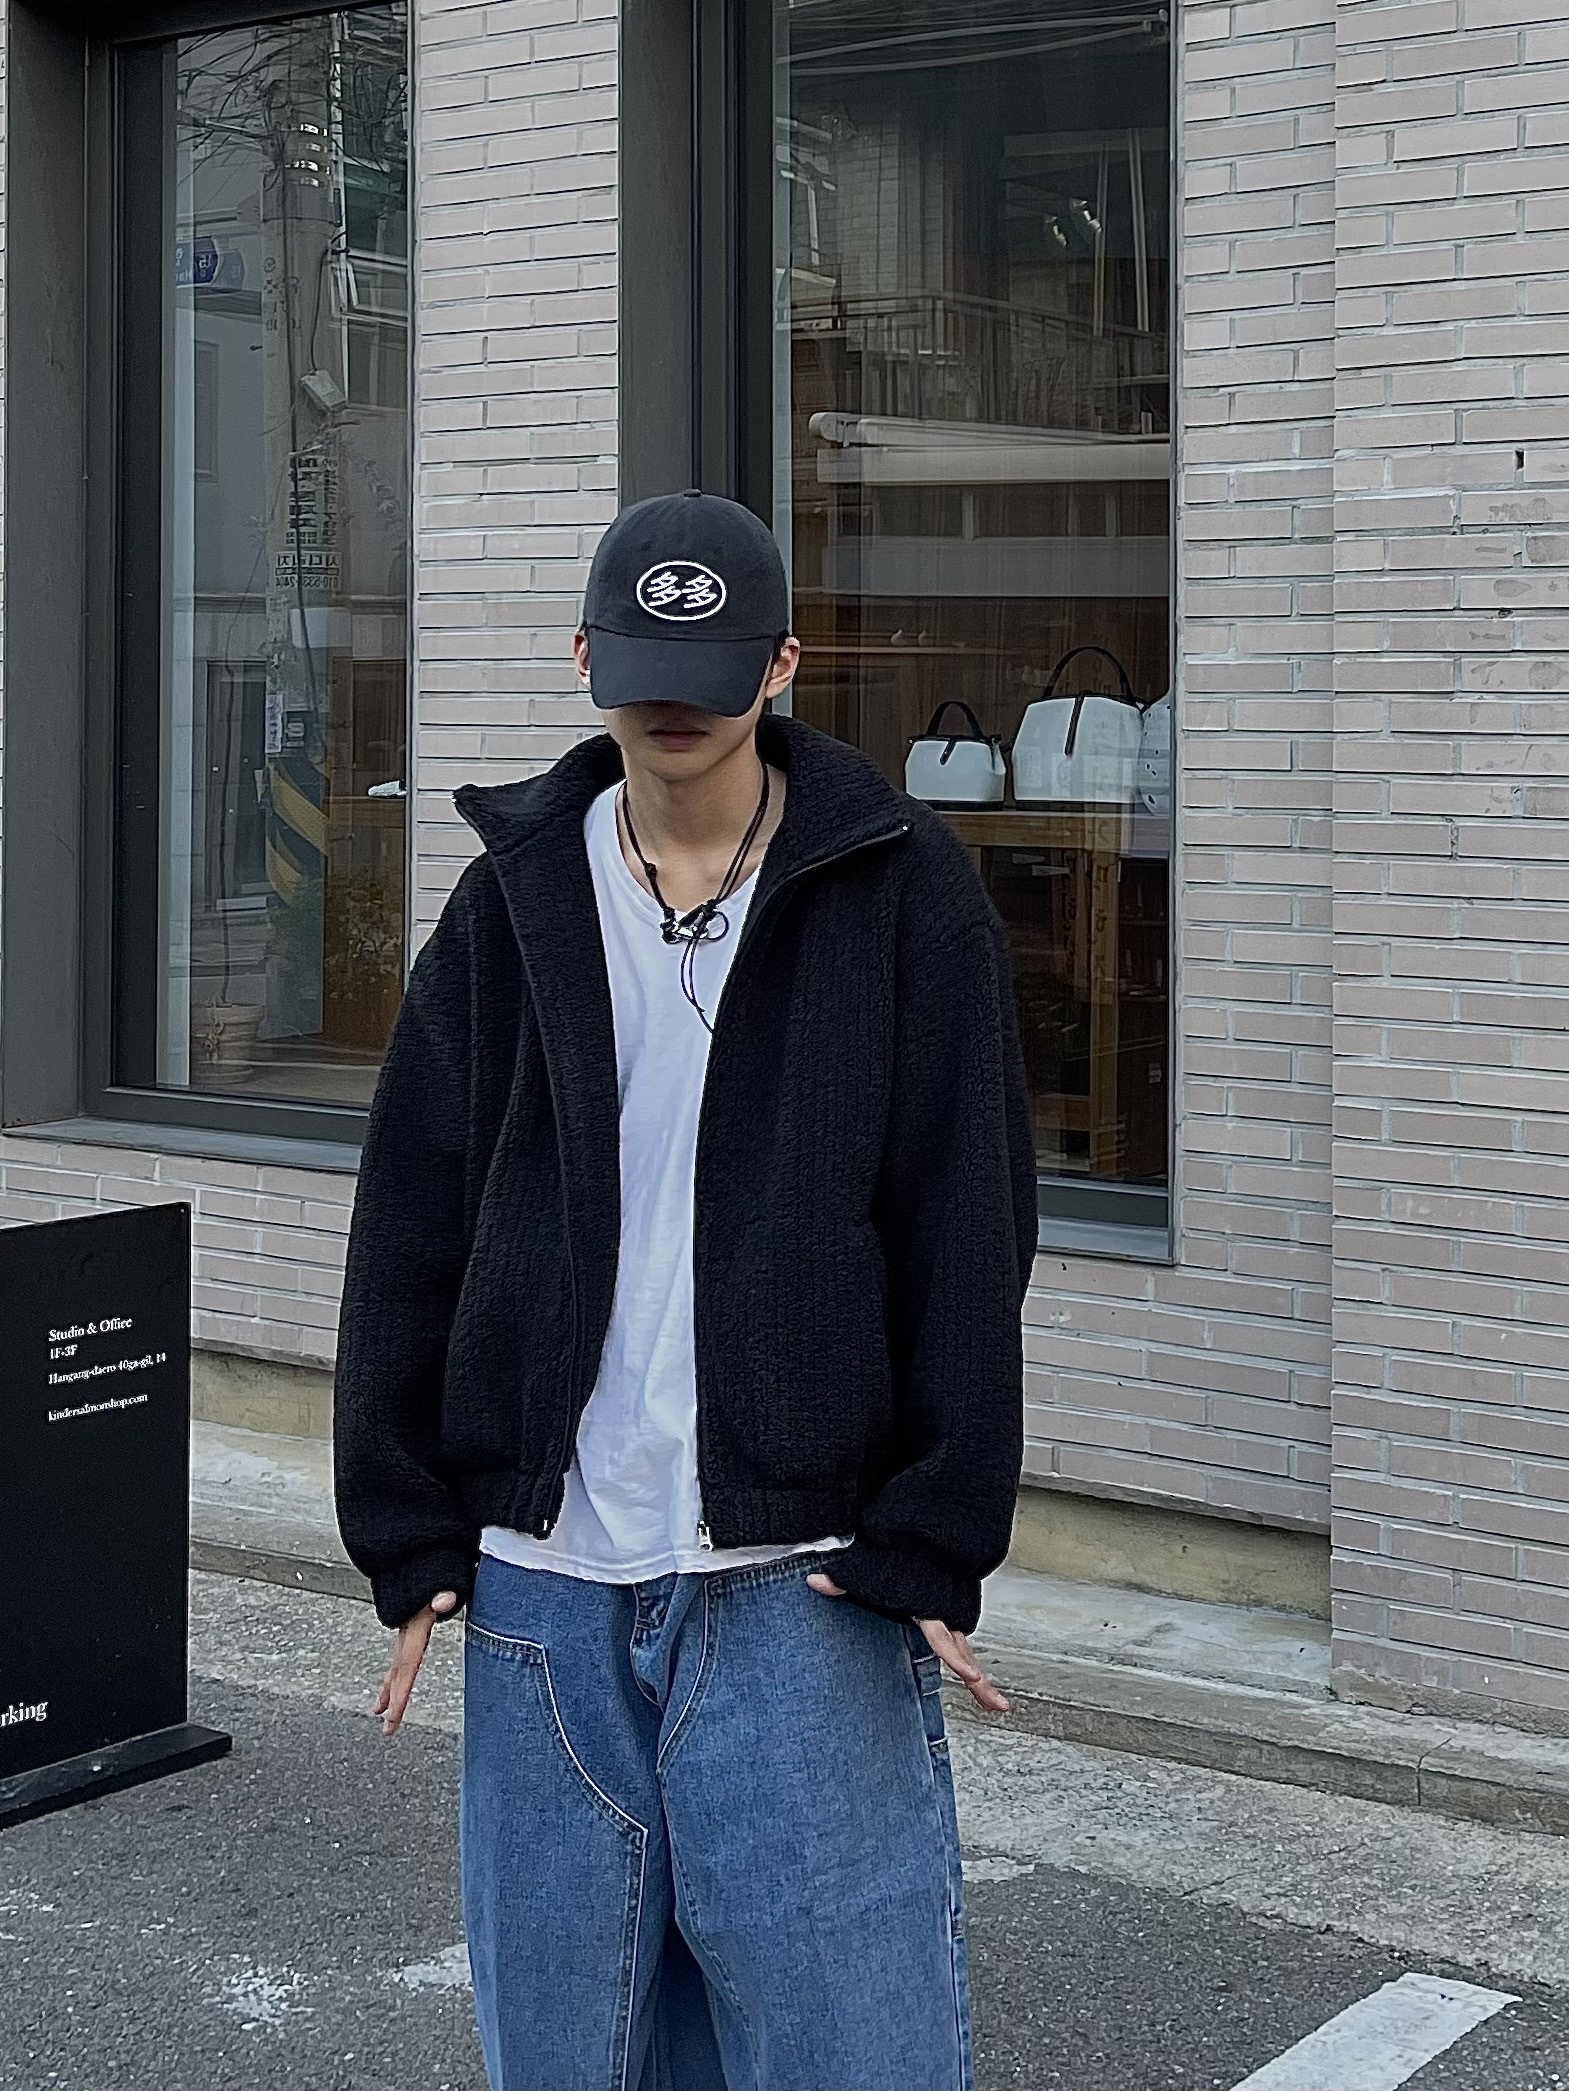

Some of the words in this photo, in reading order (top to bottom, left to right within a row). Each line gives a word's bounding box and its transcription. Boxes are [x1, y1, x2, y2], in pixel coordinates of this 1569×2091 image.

[48, 1325, 85, 1342] Studio
[86, 1322, 97, 1335] &
[99, 1317, 133, 1332] Office
[48, 1364, 117, 1385] Hangang-daero
[48, 1394, 149, 1422] kindersalmonshop.com
[0, 1701, 48, 1727] rking
